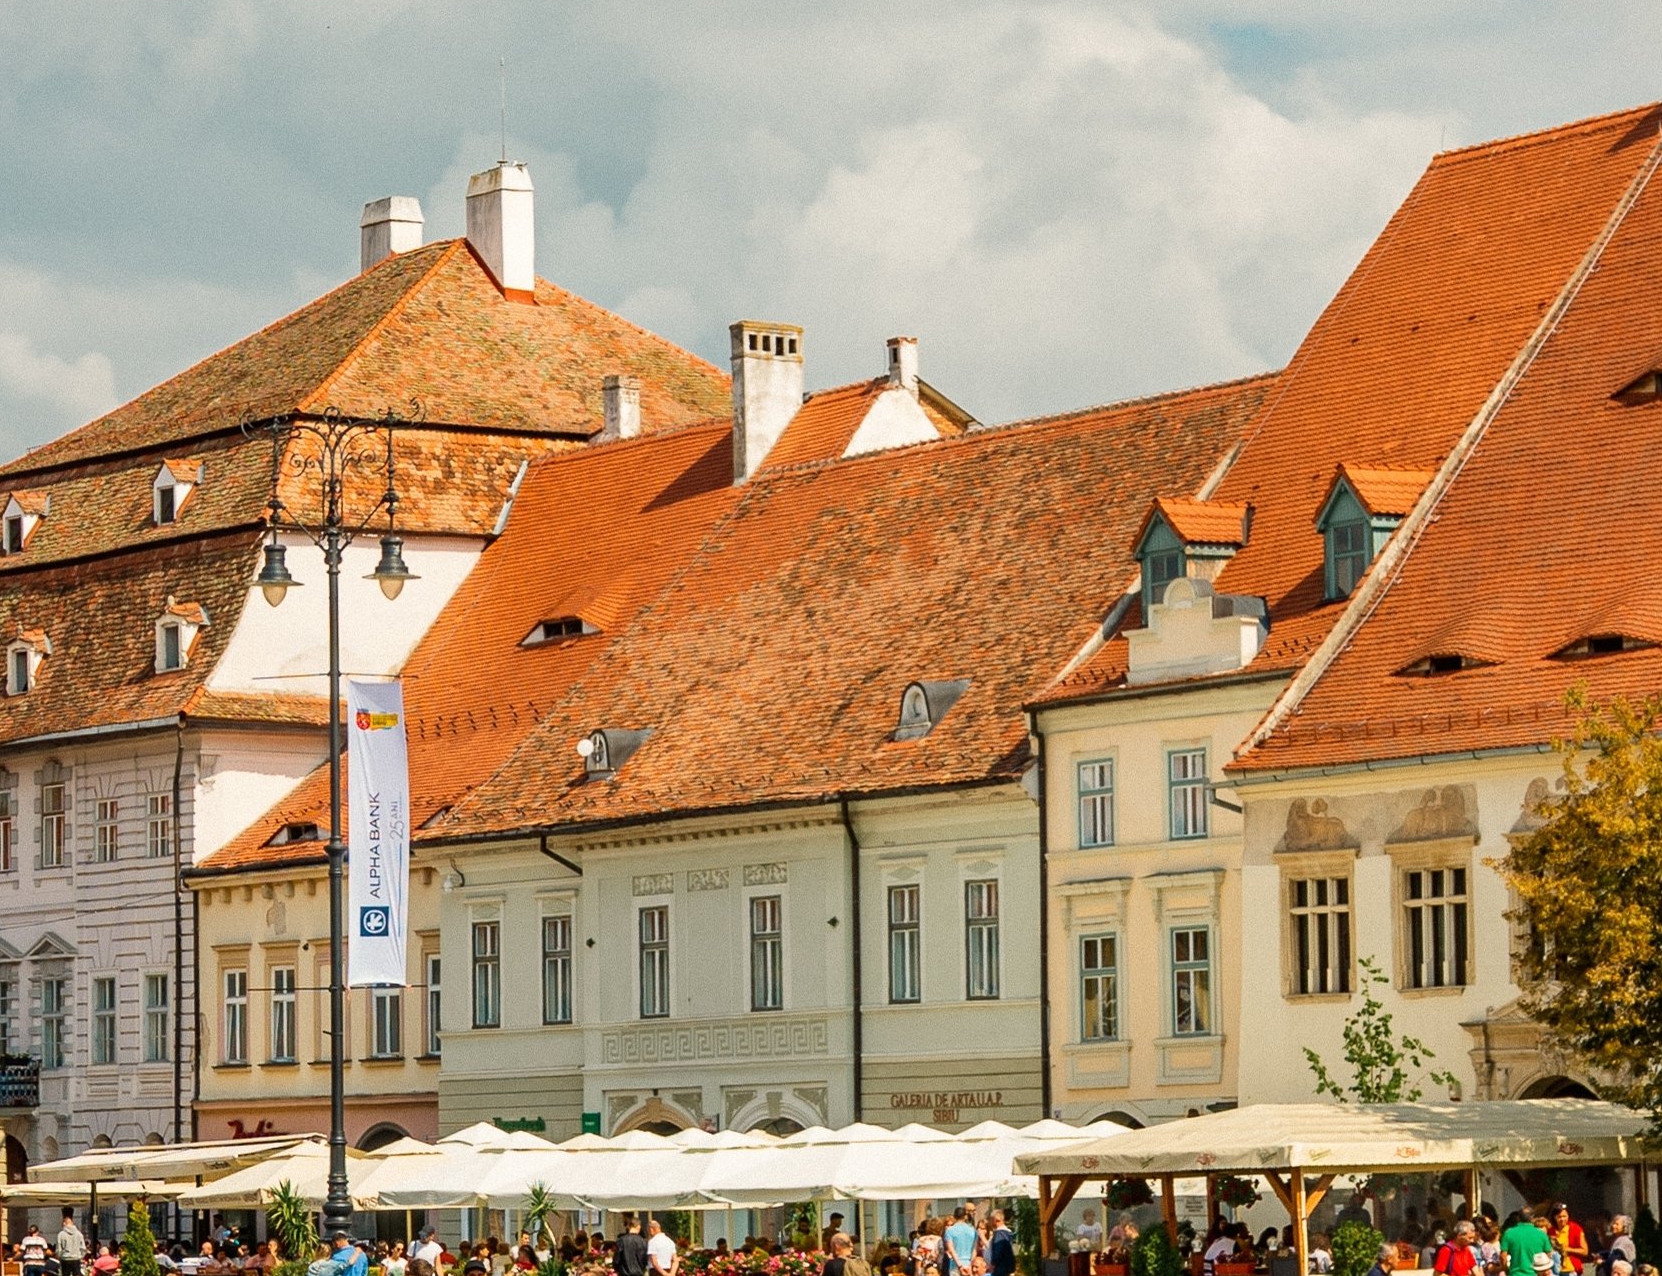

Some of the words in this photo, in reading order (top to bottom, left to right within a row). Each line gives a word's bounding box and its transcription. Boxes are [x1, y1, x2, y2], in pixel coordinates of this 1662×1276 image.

[369, 792, 381, 840] BANK
[389, 820, 405, 840] 25
[369, 844, 381, 899] ALPHA
[890, 1093, 933, 1107] GALERIA
[935, 1093, 948, 1106] DE
[933, 1109, 960, 1123] SIBIU
